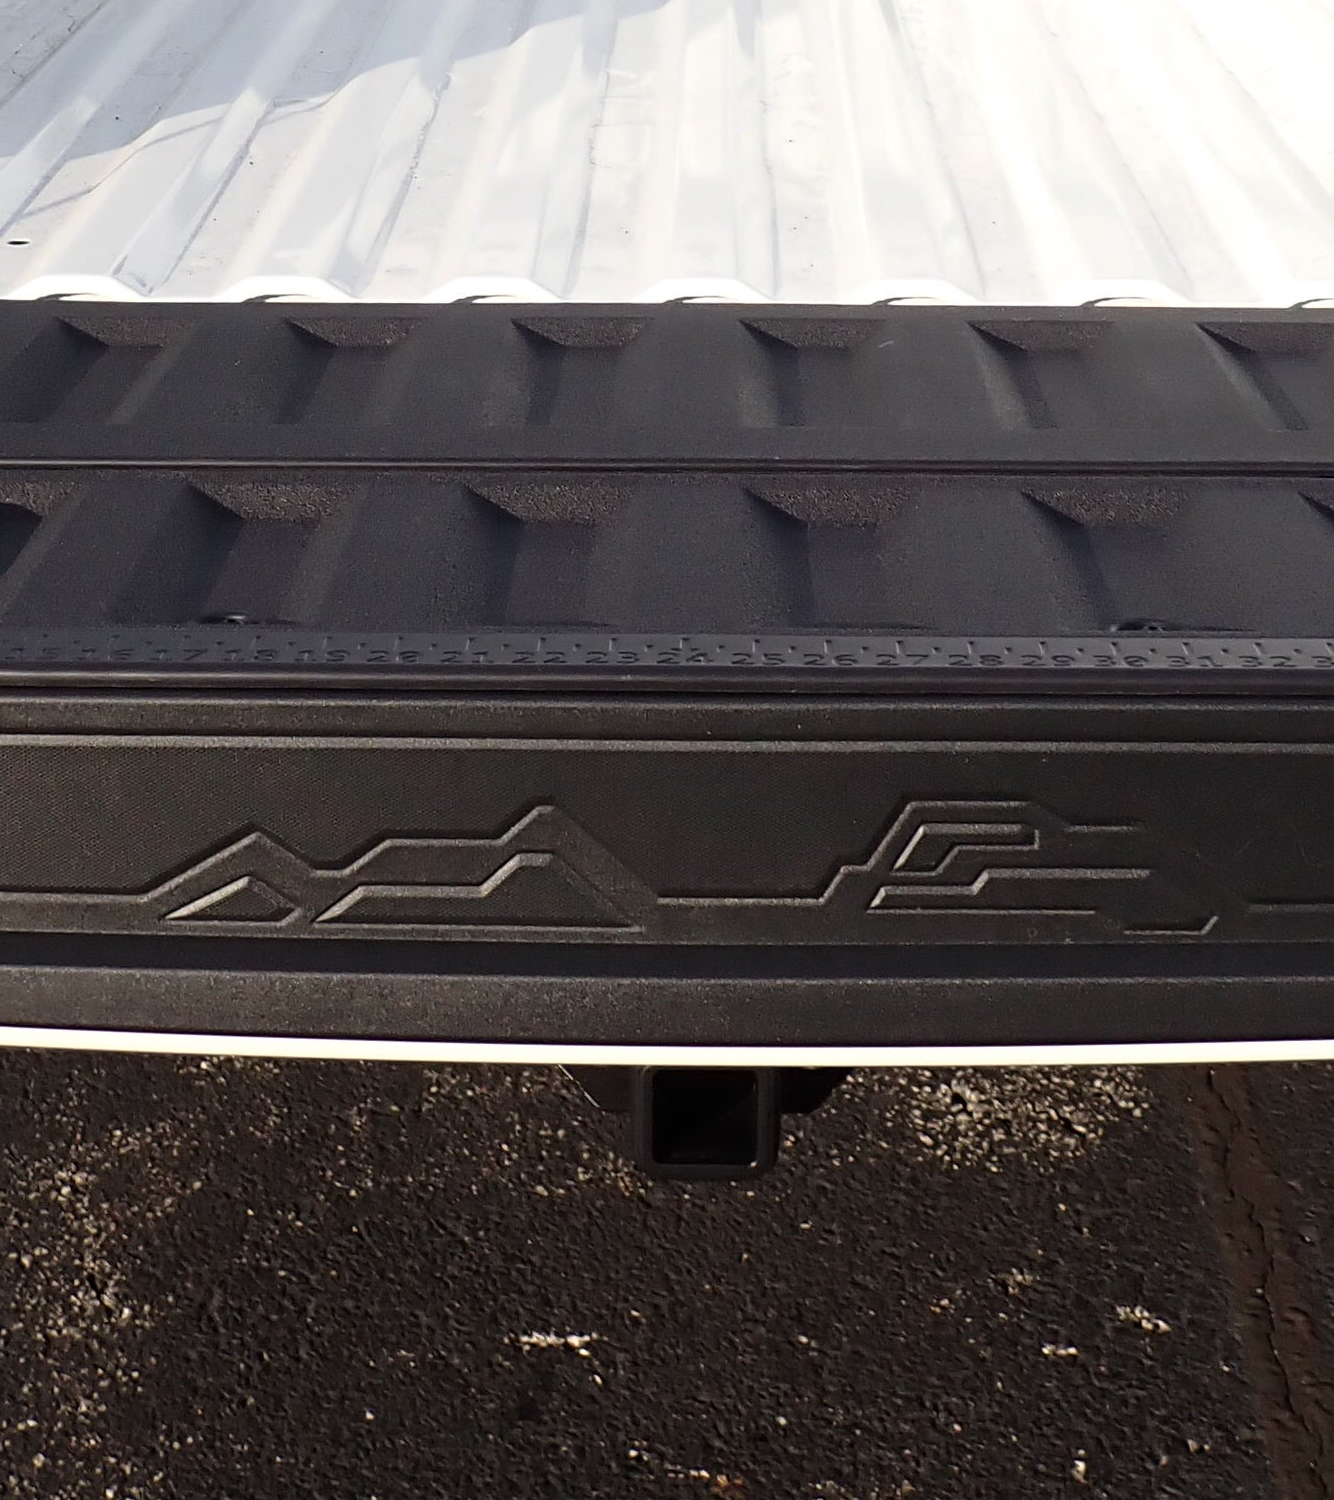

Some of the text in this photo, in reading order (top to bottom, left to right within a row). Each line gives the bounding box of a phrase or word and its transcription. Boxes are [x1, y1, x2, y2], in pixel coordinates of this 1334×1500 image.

[150, 649, 208, 661] 17
[223, 649, 277, 661] 18
[295, 649, 351, 662] 19
[366, 650, 422, 662] 20
[440, 651, 494, 663] 21
[511, 651, 567, 663] 22
[585, 651, 640, 663] 23
[656, 651, 714, 663] 24
[730, 652, 785, 665] 25
[802, 653, 858, 665] 26
[875, 653, 930, 665] 27
[947, 654, 1004, 666] 28
[1020, 654, 1075, 667] 29
[1091, 654, 1149, 667] 30
[1165, 655, 1223, 667] 31
[1237, 655, 1298, 667] 32
